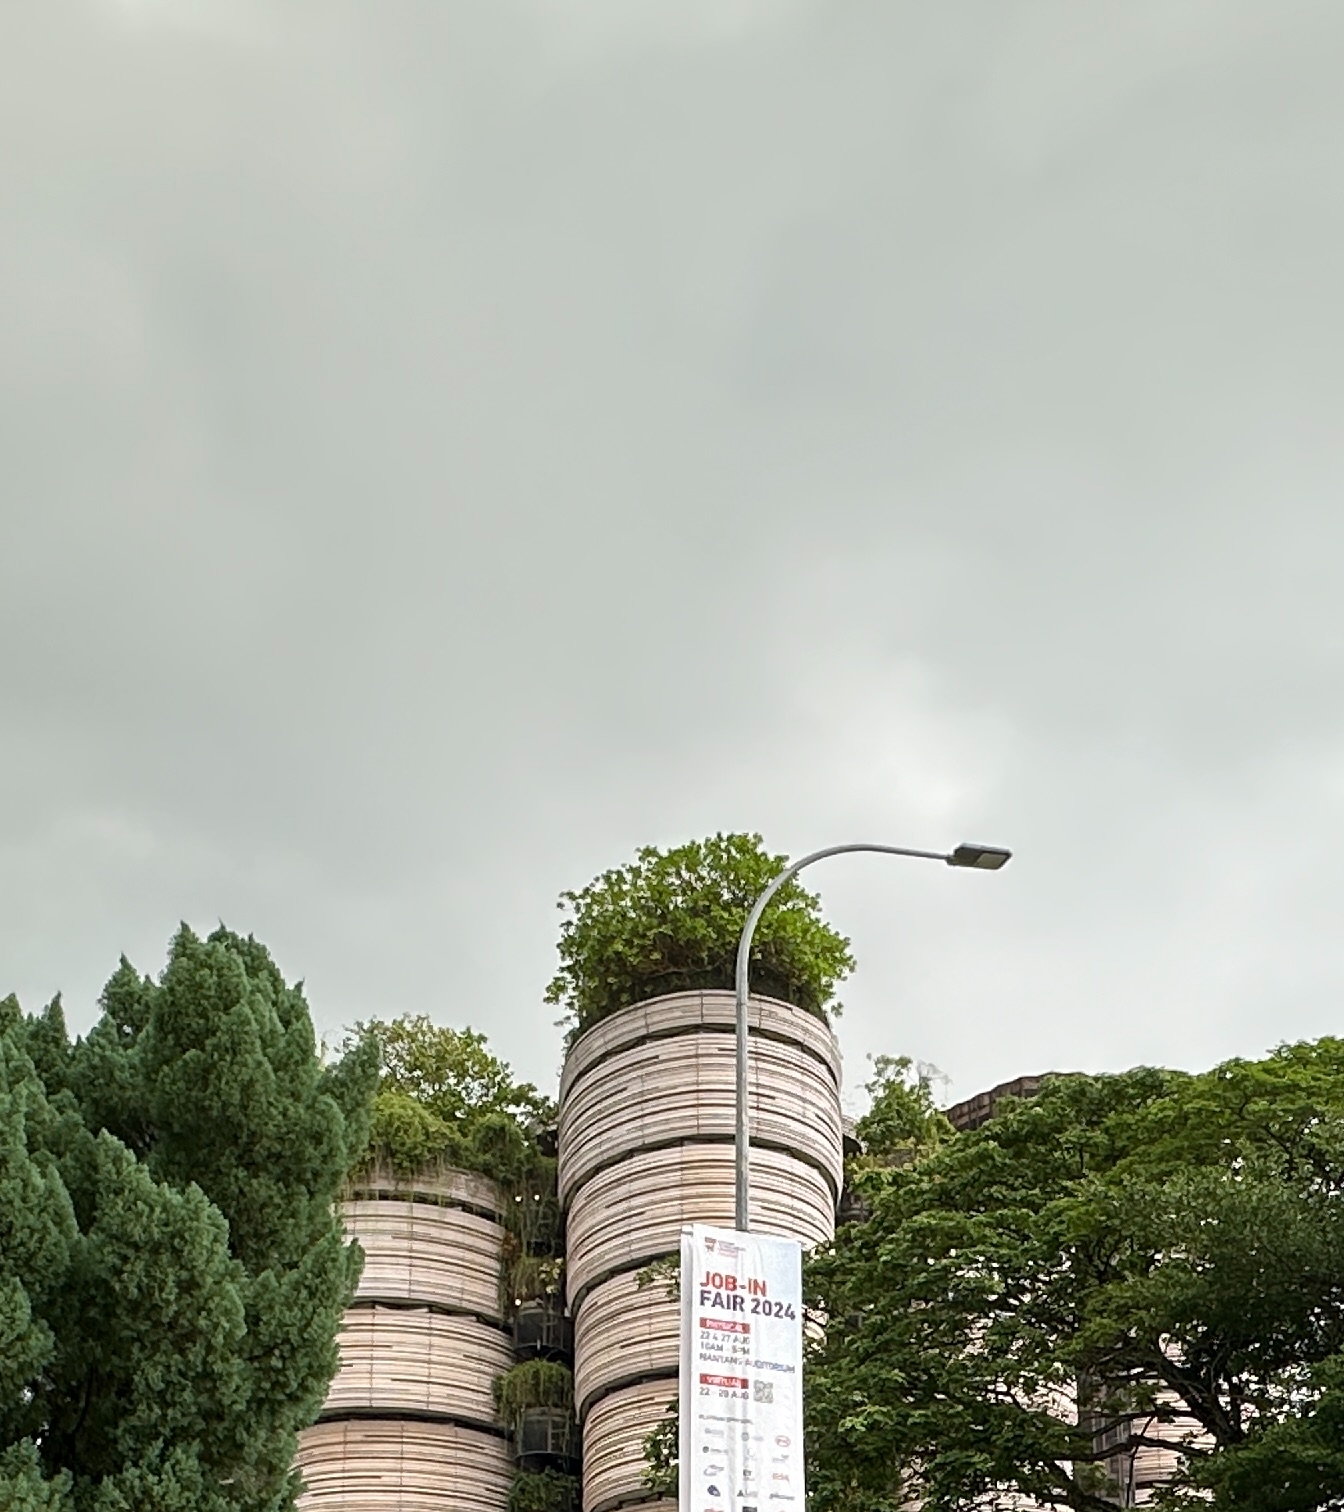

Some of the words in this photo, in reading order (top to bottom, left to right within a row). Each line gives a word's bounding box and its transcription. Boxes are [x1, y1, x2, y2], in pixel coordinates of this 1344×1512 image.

[699, 1271, 767, 1297] JOB-IN
[699, 1290, 745, 1312] FAIR
[750, 1298, 796, 1320] 2024
